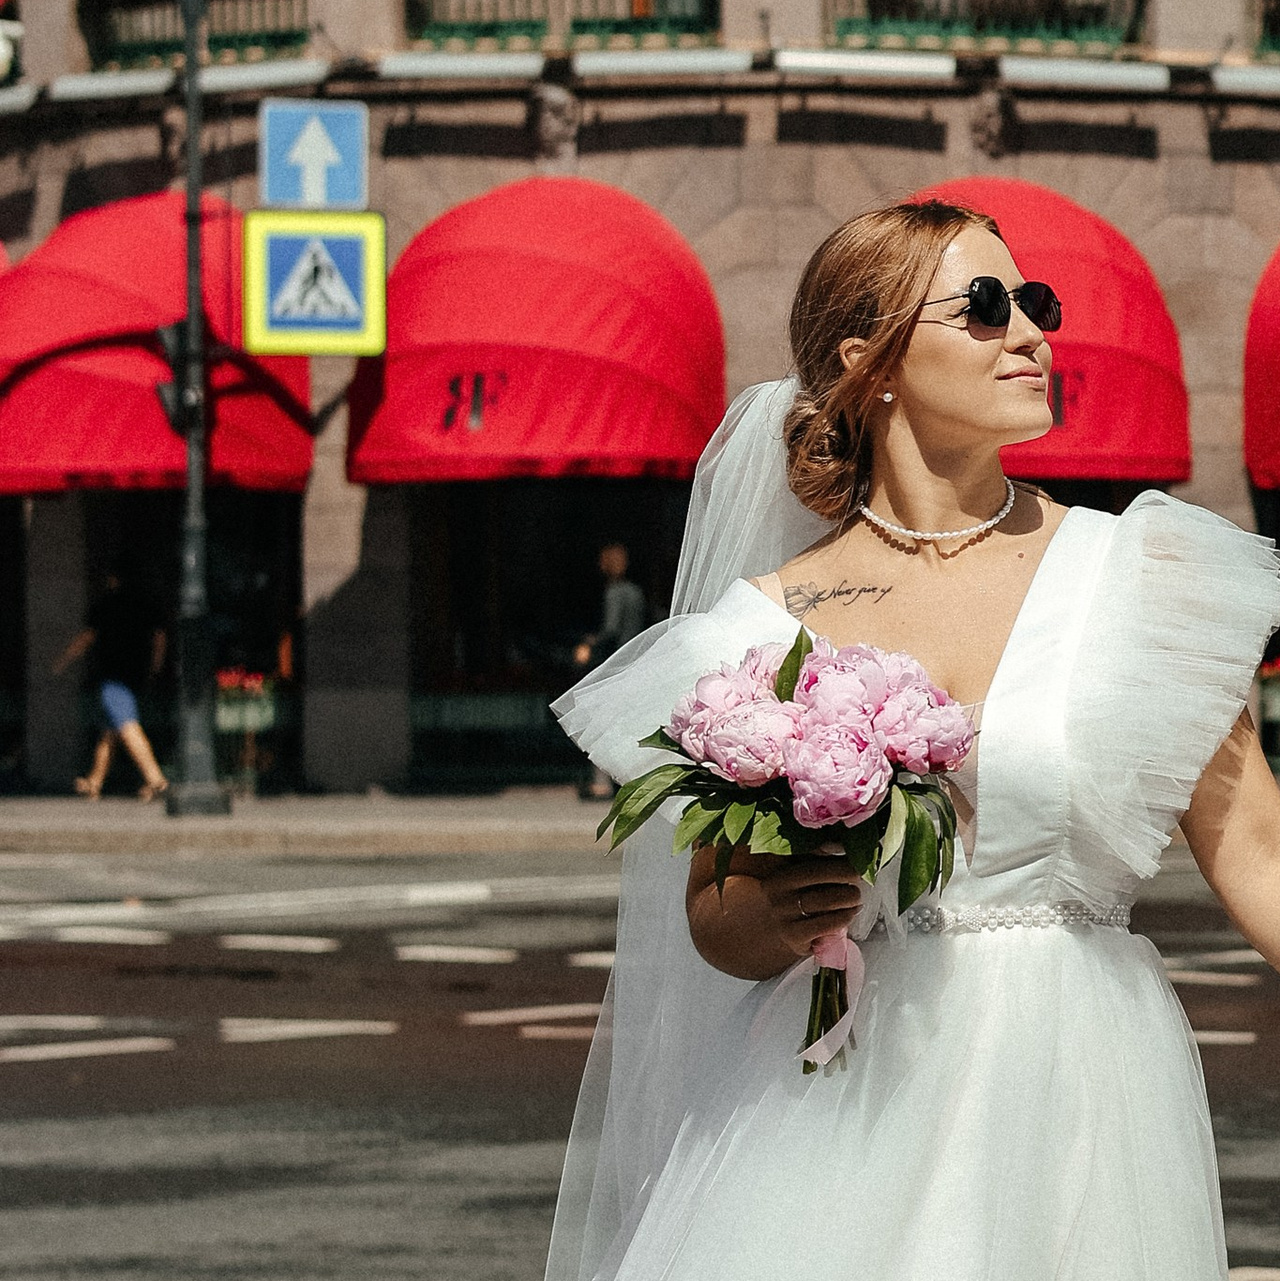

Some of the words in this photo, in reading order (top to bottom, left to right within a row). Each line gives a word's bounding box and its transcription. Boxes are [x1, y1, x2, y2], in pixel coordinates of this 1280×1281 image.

[823, 579, 857, 601] Never
[843, 584, 877, 606] give
[874, 585, 893, 604] up
